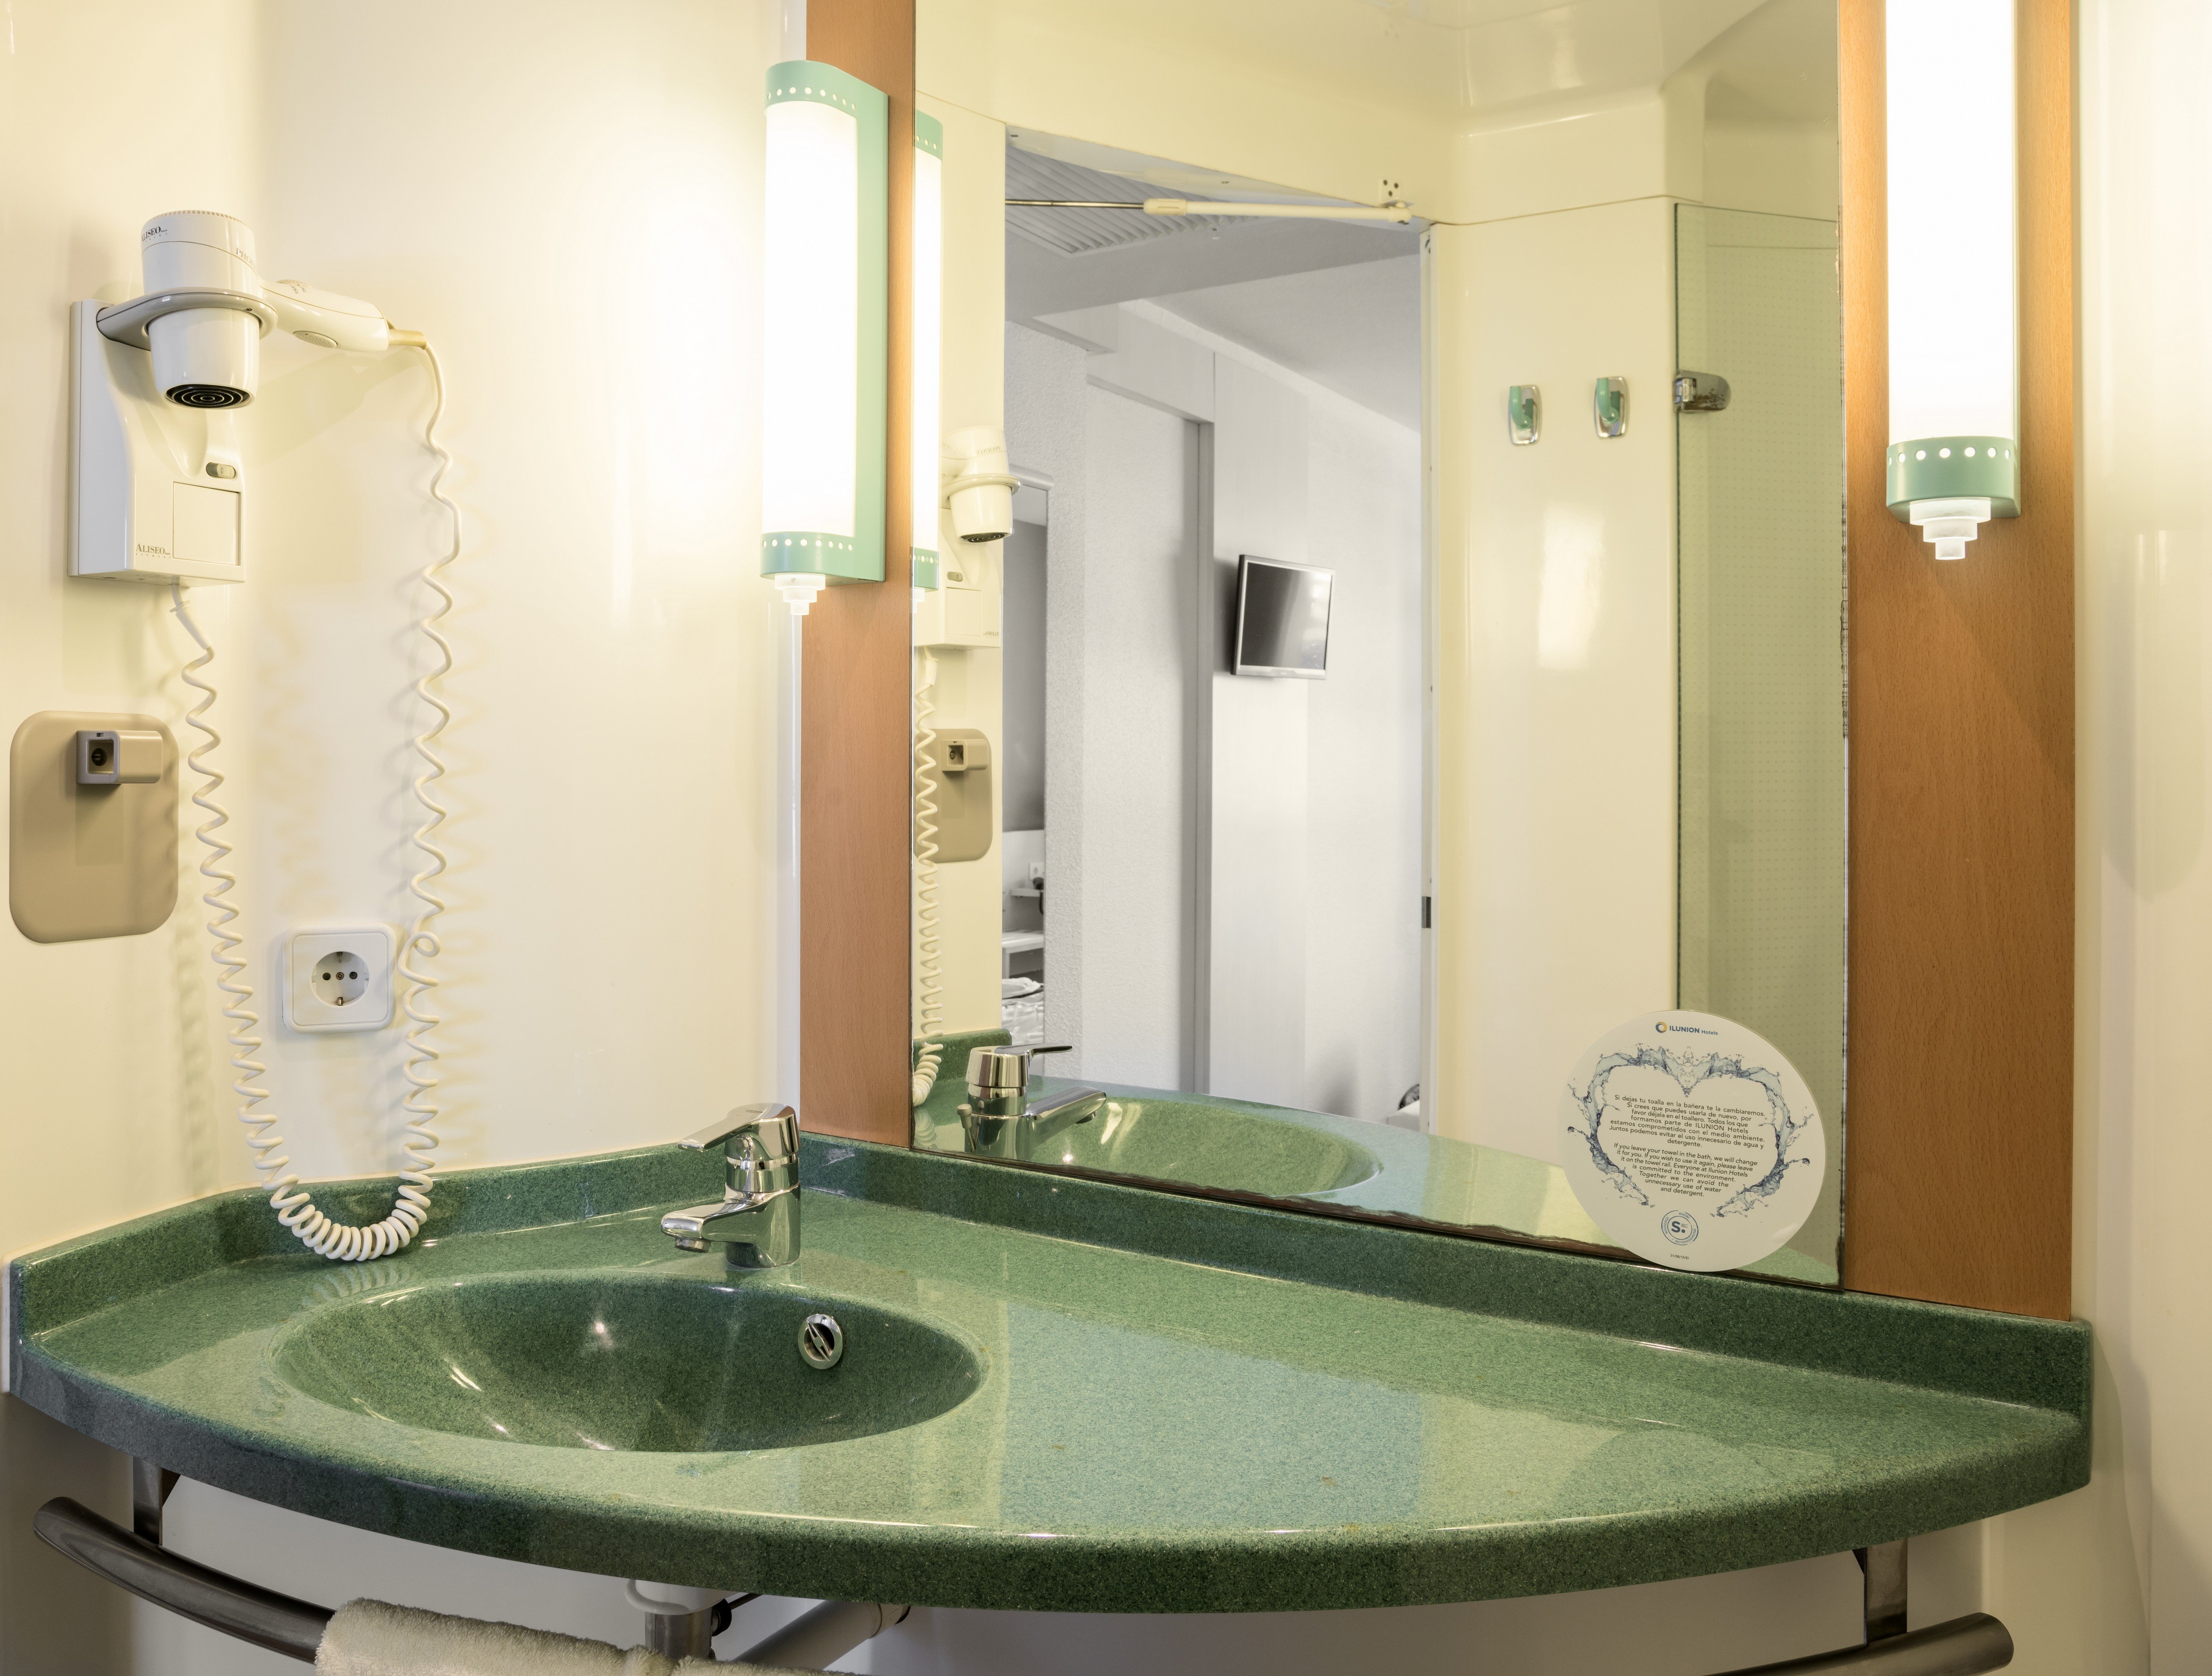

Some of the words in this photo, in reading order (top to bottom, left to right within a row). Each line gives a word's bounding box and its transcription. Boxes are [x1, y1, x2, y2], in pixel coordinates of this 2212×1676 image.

[135, 543, 165, 555] ALISEO
[1669, 1025, 1700, 1034] ILUNION
[1723, 1108, 1765, 1116] cambiaremos.
[1631, 1115, 1661, 1124] formamos
[1638, 1124, 1686, 1132] comprometidos
[1667, 1138, 1702, 1147] detergente.
[1697, 1135, 1731, 1144] innecesario
[1696, 1173, 1736, 1182] environment.
[1645, 1179, 1681, 1189] unnecessary
[1673, 1188, 1704, 1197] detergent.
[1675, 1228, 1696, 1244] environmental
